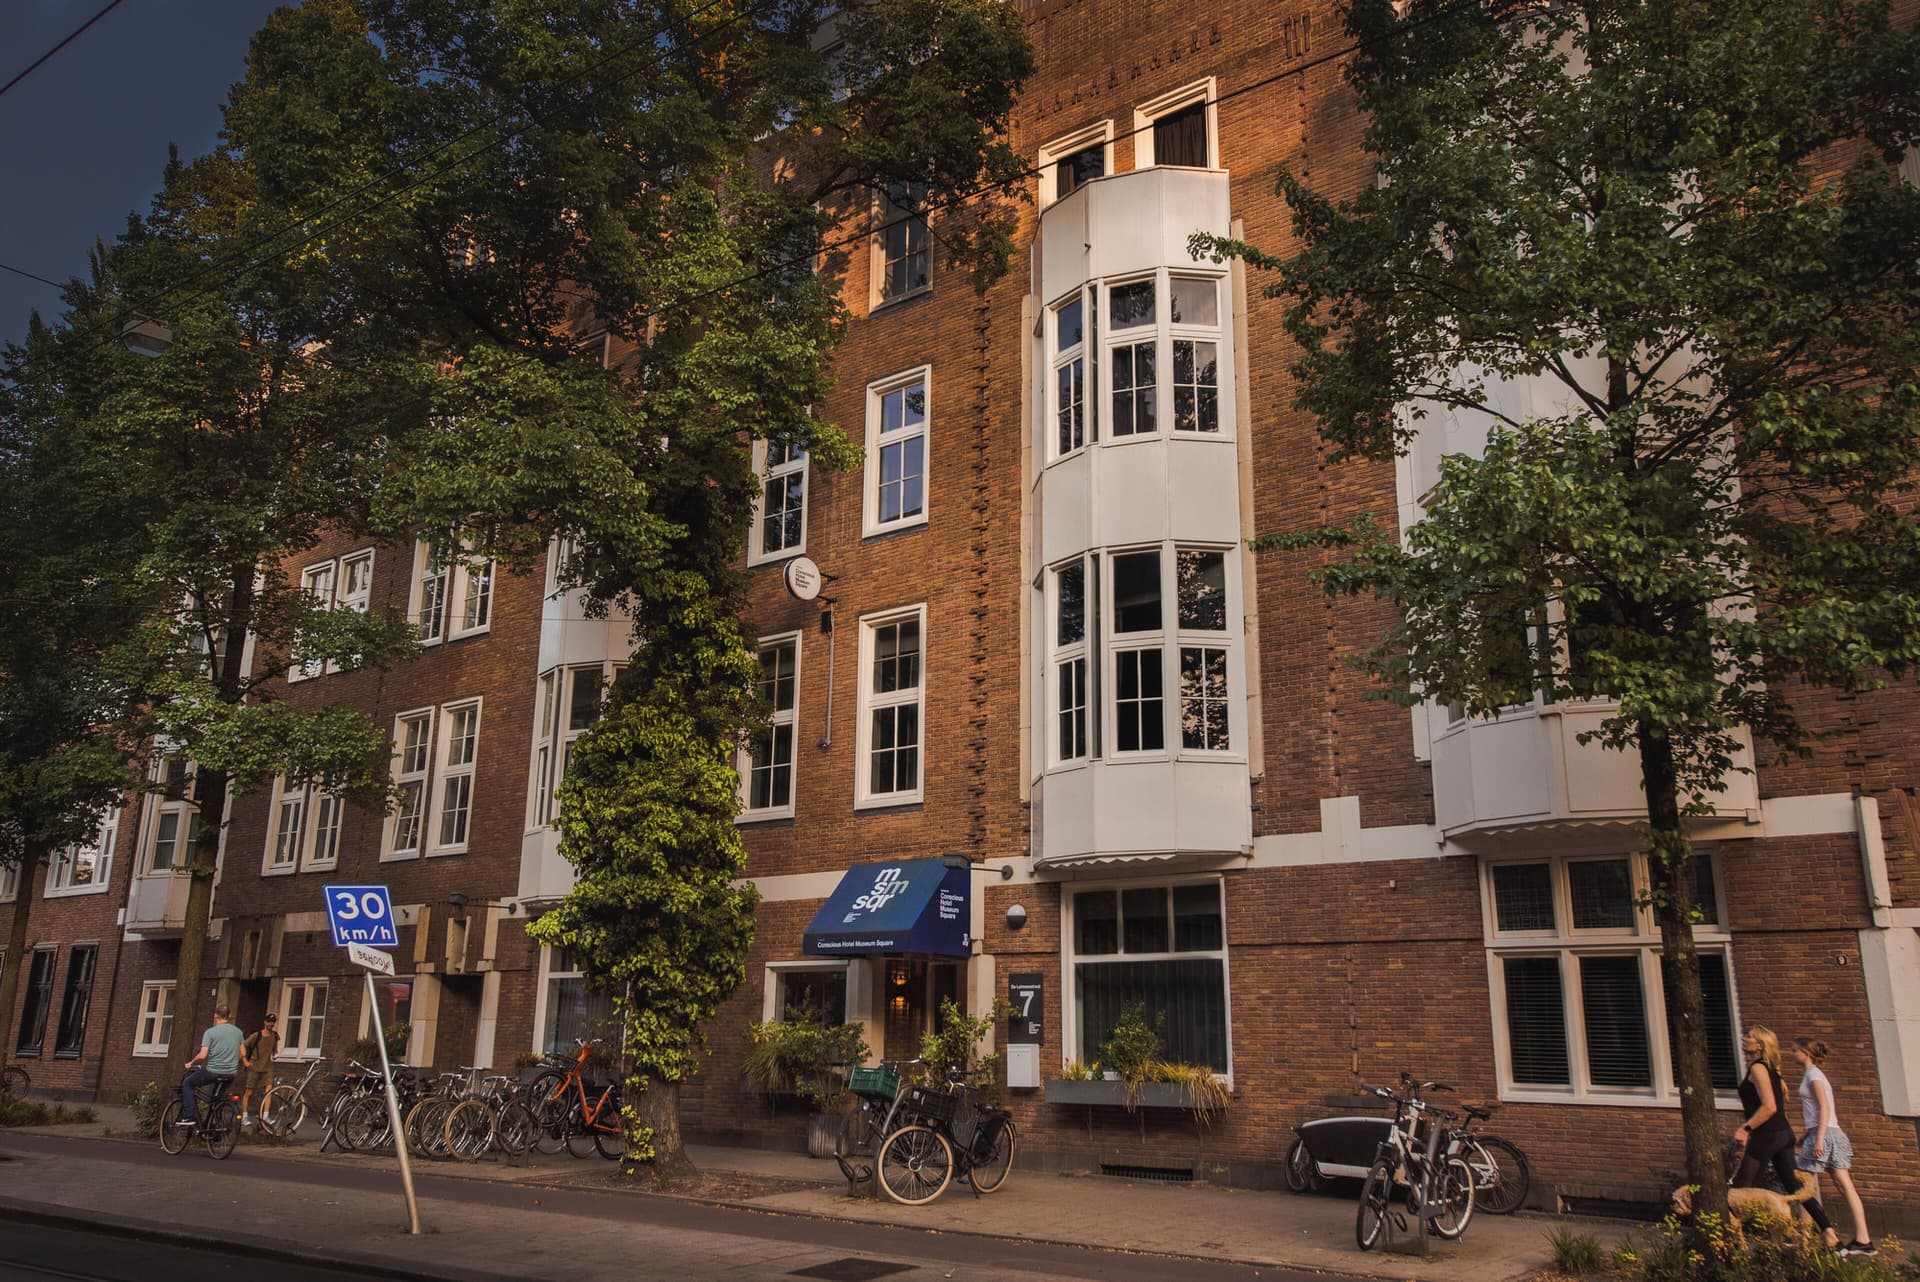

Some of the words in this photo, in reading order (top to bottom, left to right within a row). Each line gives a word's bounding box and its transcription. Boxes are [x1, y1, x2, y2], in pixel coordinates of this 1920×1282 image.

[875, 868, 901, 883] m
[852, 894, 895, 913] sqr
[940, 892, 964, 902] Conscious
[940, 899, 953, 907] Hotel
[336, 892, 385, 920] 30
[940, 911, 956, 920] Square
[340, 925, 392, 940] km/h
[842, 940, 855, 948] Hotel
[855, 940, 876, 948] Museum
[876, 939, 894, 947] Square
[1020, 990, 1034, 1017] 7
